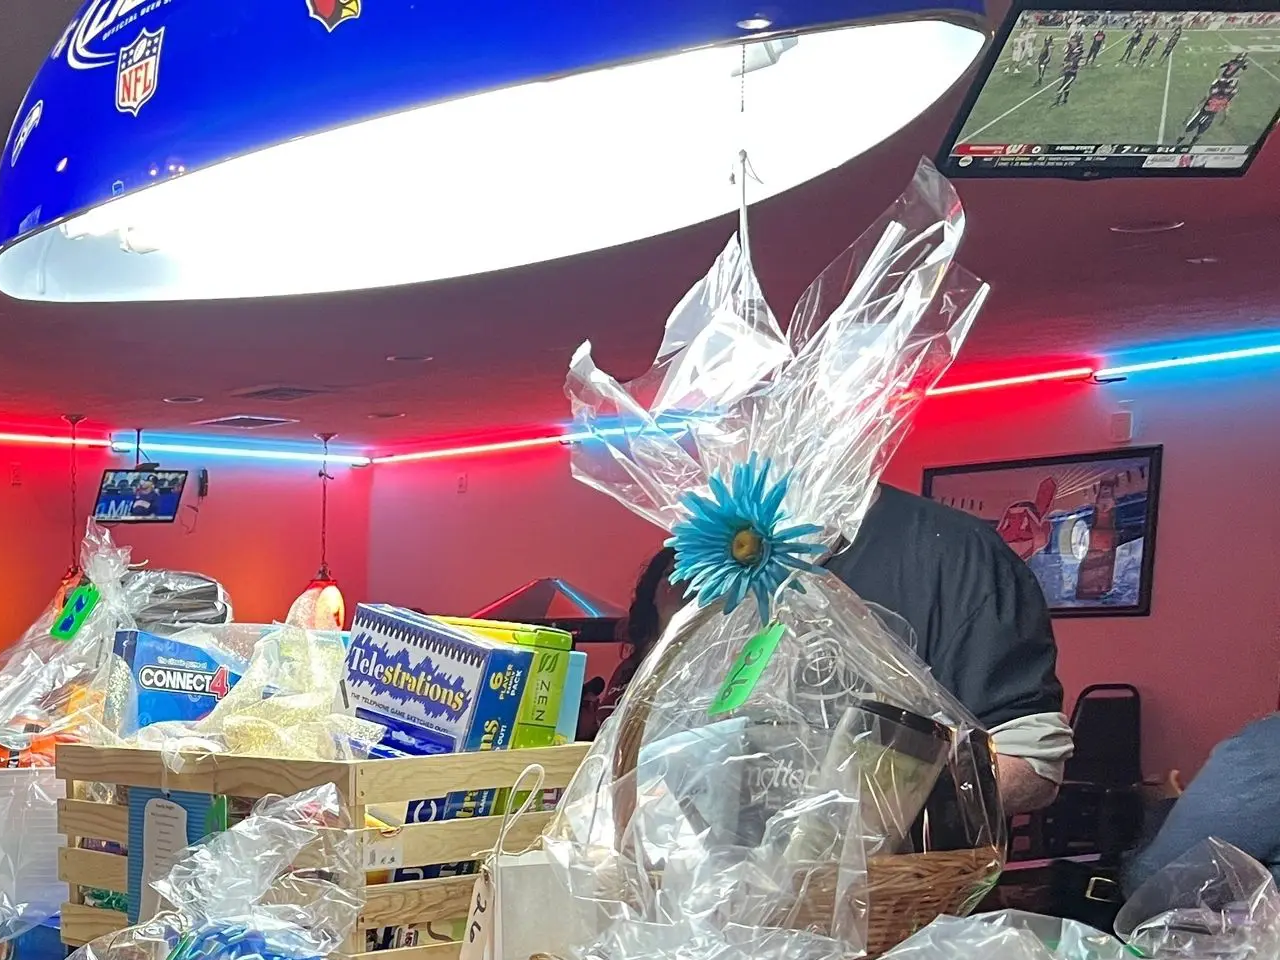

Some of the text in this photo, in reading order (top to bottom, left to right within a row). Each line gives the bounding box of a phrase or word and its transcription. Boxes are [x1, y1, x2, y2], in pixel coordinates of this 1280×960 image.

[102, 13, 138, 41] OFFICIAL
[120, 61, 153, 102] NFL
[141, 666, 229, 699] CONNECT 4
[350, 646, 465, 711] Telestrations
[489, 672, 504, 690] 6
[499, 664, 513, 700] PLAYER
[510, 669, 523, 696] PACK
[361, 695, 389, 713] TELEPHONE
[390, 707, 407, 719] GAME
[407, 712, 434, 729] SKETCHED
[535, 680, 551, 721] ZEN
